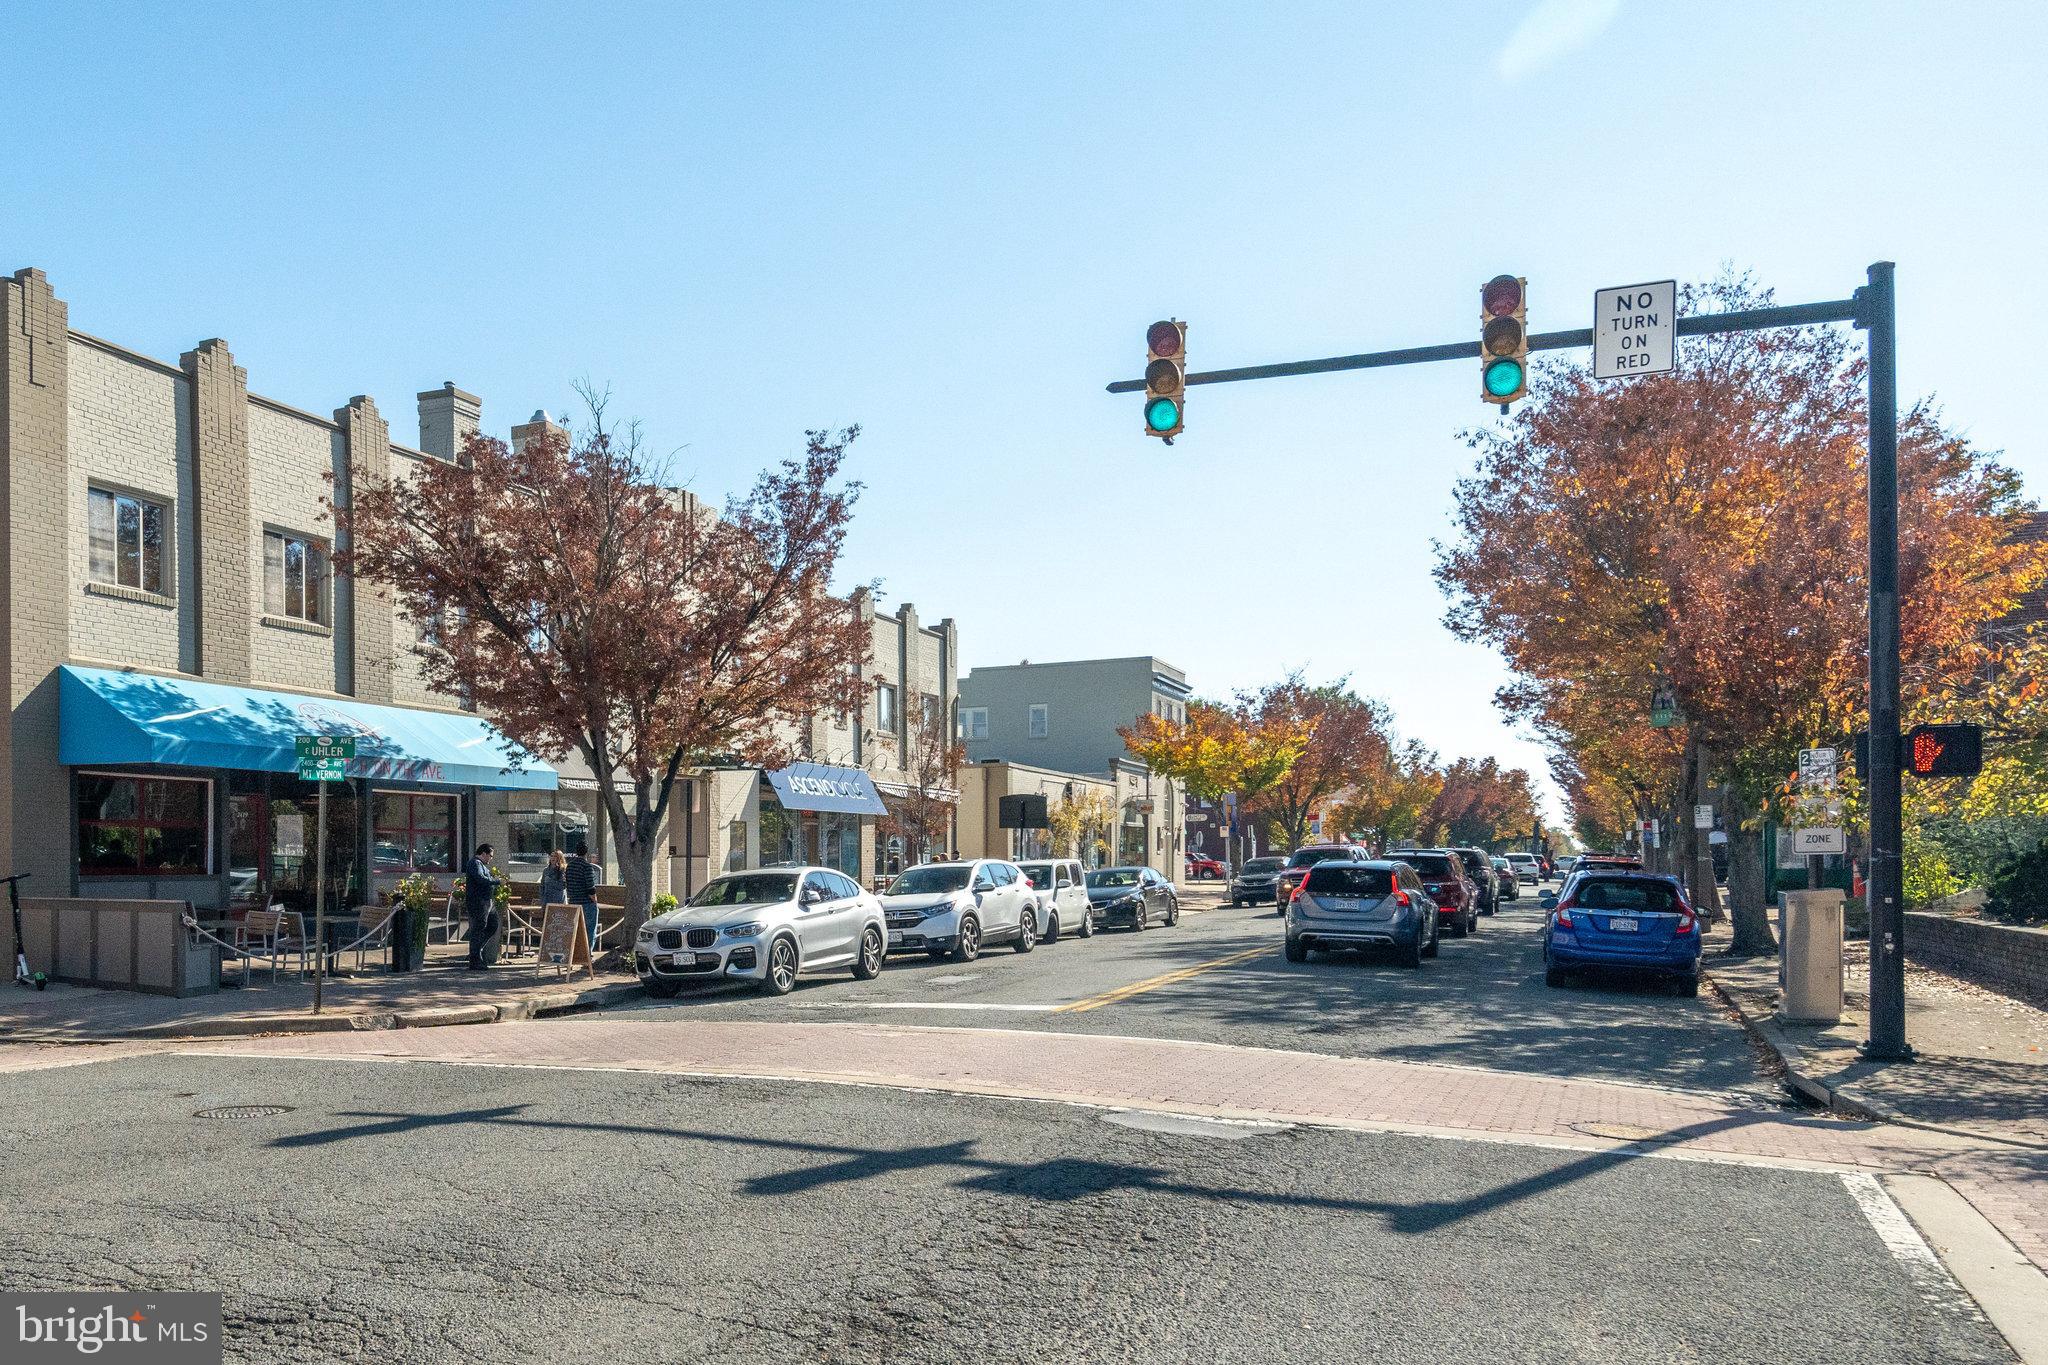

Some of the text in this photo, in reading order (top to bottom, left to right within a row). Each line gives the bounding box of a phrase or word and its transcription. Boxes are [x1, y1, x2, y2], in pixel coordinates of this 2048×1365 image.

[1617, 292, 1653, 312] NO
[1612, 313, 1658, 331] TURN
[1621, 334, 1647, 350] ON
[1617, 353, 1651, 370] RED
[311, 746, 344, 757] UHLER
[315, 769, 343, 780] VERNON
[375, 761, 391, 775] ON
[397, 761, 416, 776] THE
[421, 764, 445, 780] AVE.
[1805, 834, 1832, 844] ZONE
